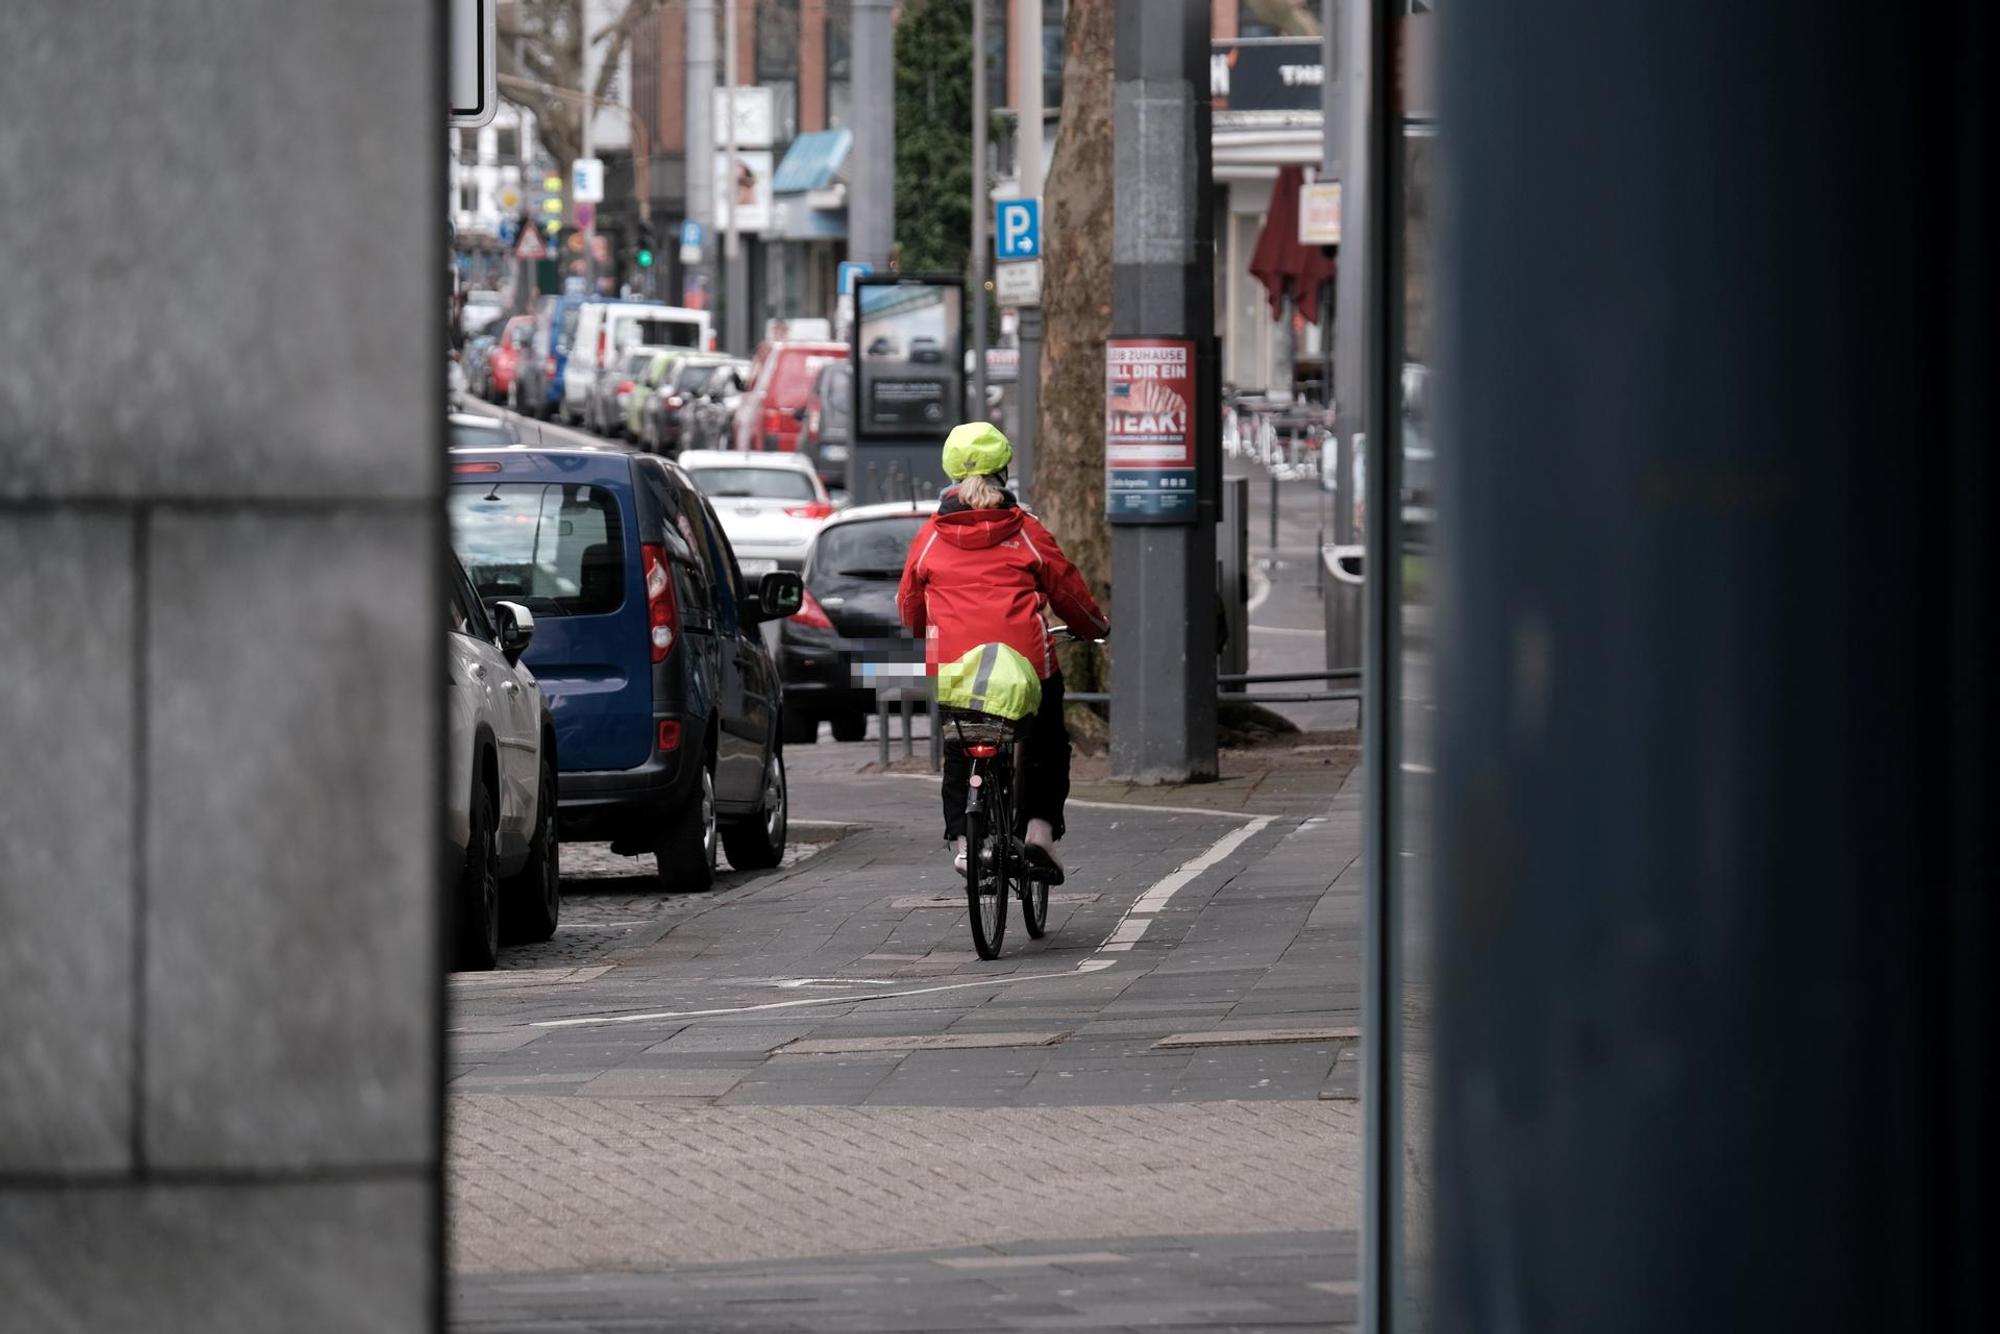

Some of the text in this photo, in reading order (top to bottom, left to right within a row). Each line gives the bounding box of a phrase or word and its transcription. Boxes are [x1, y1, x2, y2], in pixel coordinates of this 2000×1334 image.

[1005, 206, 1030, 252] P
[1129, 350, 1183, 360] ZUHAUSE
[1133, 364, 1159, 378] DIR
[1161, 364, 1187, 378] EIN
